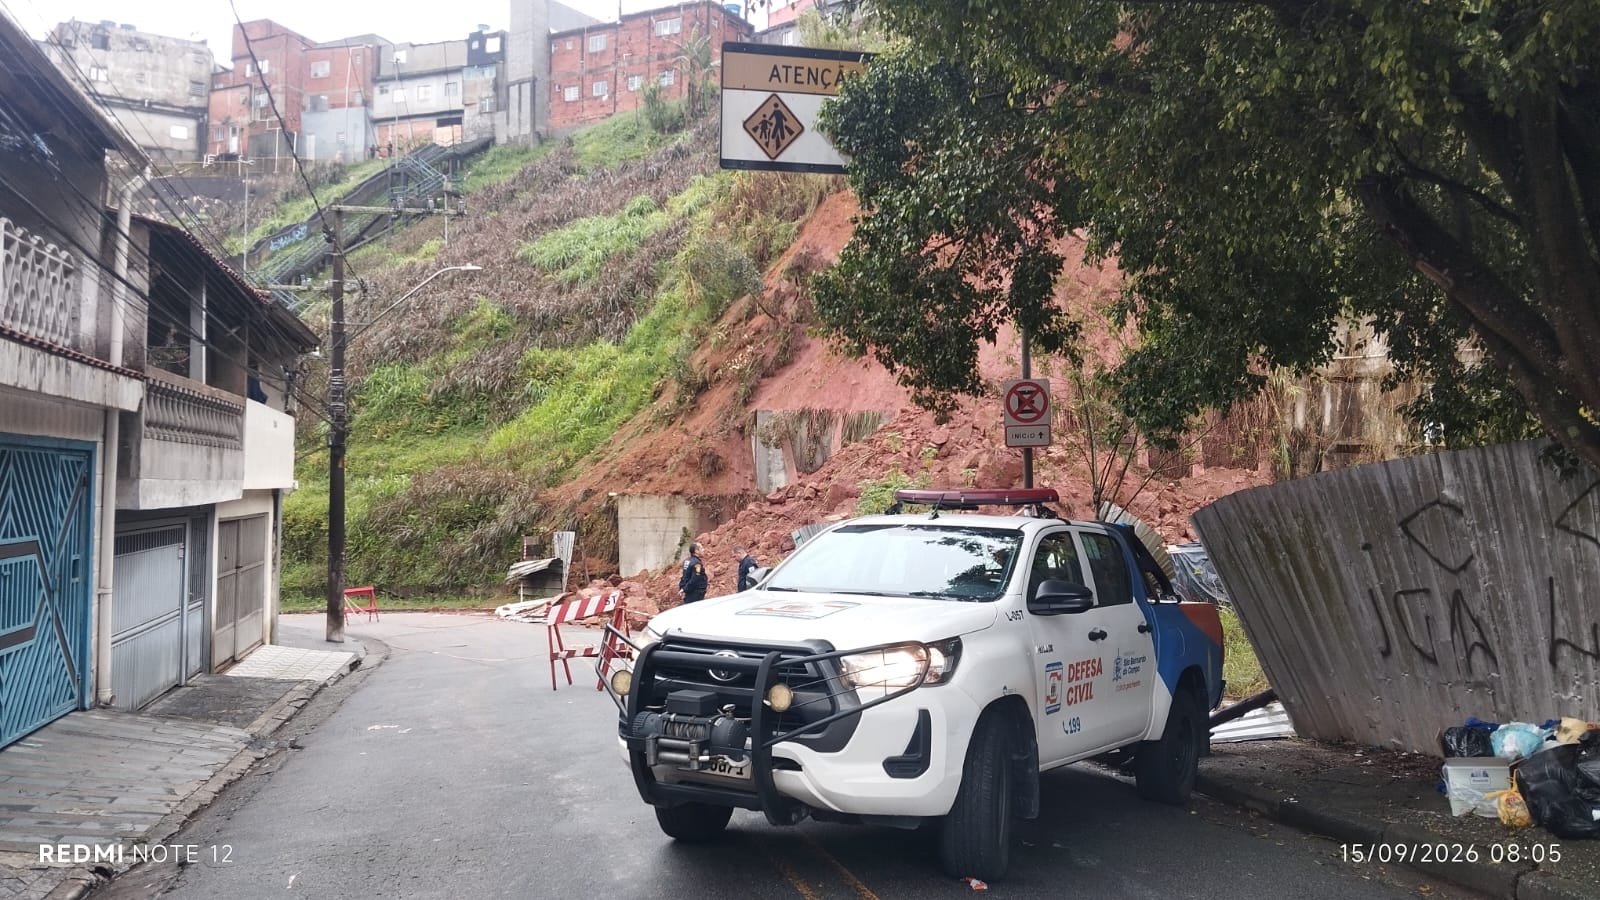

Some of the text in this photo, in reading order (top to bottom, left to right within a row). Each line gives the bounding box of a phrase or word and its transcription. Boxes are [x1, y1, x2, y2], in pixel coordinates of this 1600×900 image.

[1067, 656, 1103, 683] DEFESA
[1066, 681, 1094, 706] CIVIL
[1069, 716, 1081, 734] 199
